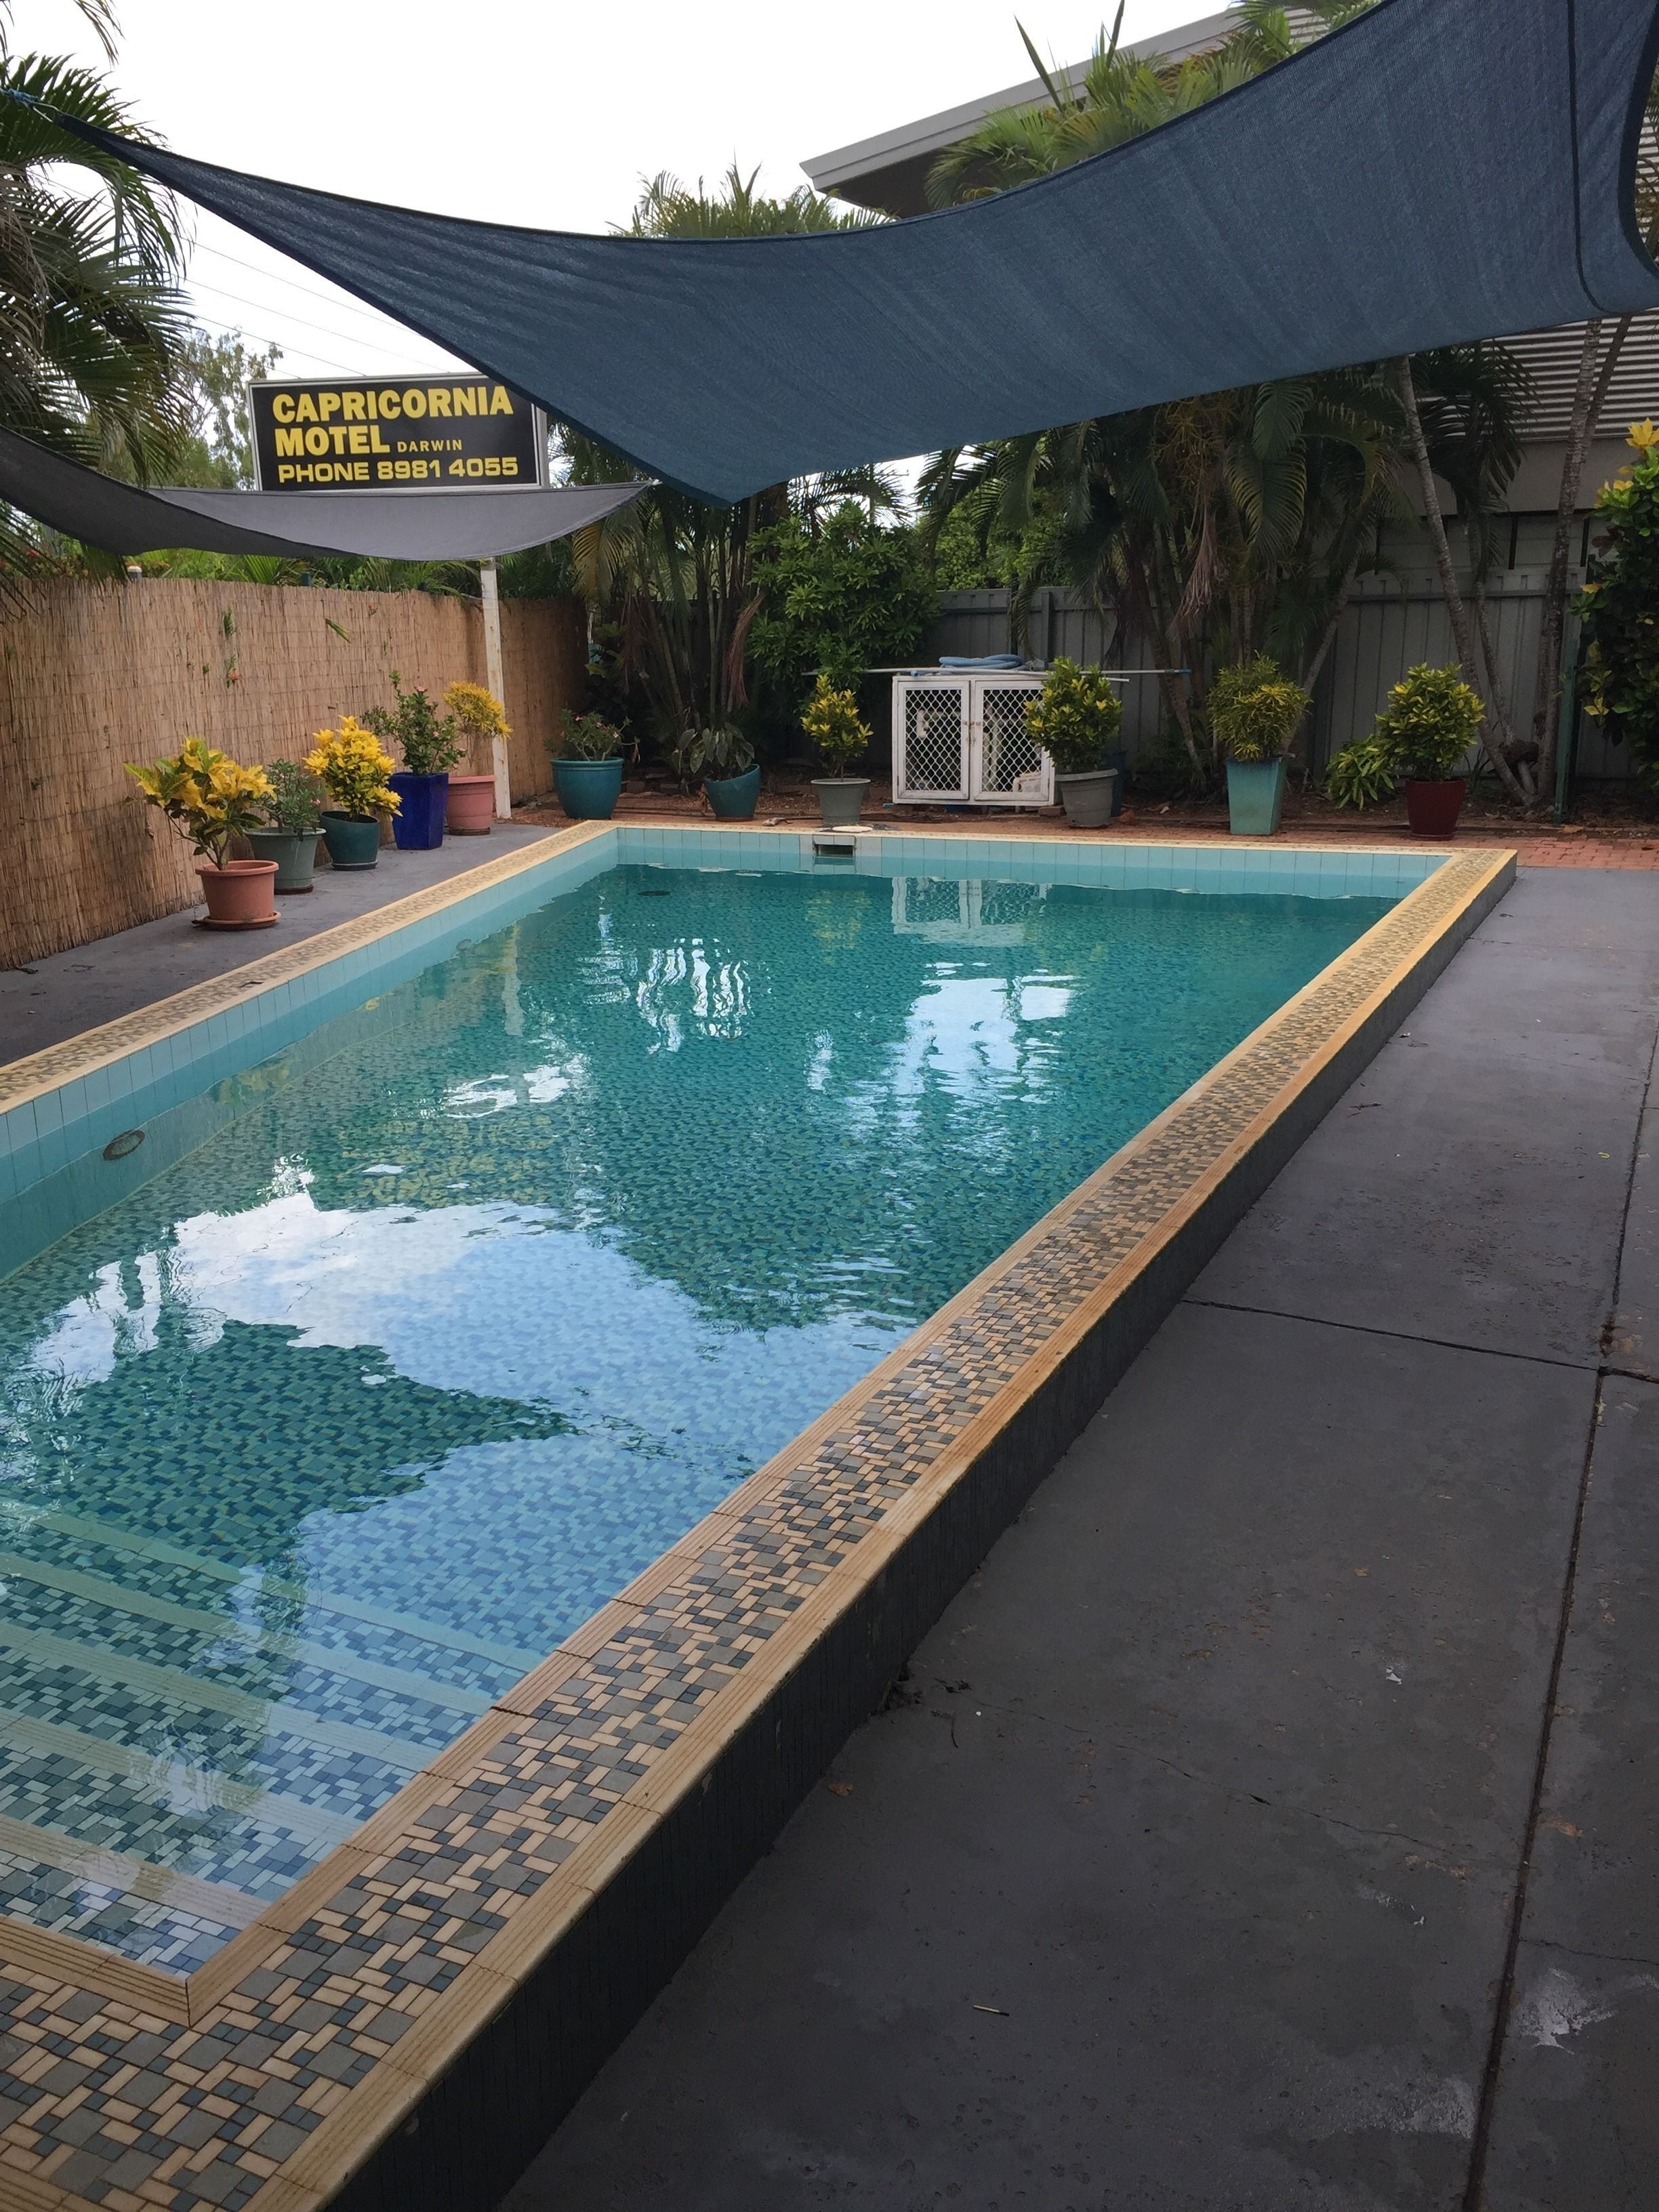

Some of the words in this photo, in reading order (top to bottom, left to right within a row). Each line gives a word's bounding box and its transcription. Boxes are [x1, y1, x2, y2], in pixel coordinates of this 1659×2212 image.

[272, 386, 514, 424] CAPRICORNIA
[274, 424, 390, 457] MOTEL
[397, 439, 463, 453] DARWIN
[278, 462, 370, 483] PHONE
[377, 459, 441, 480] 8981
[449, 457, 518, 477] 4055
